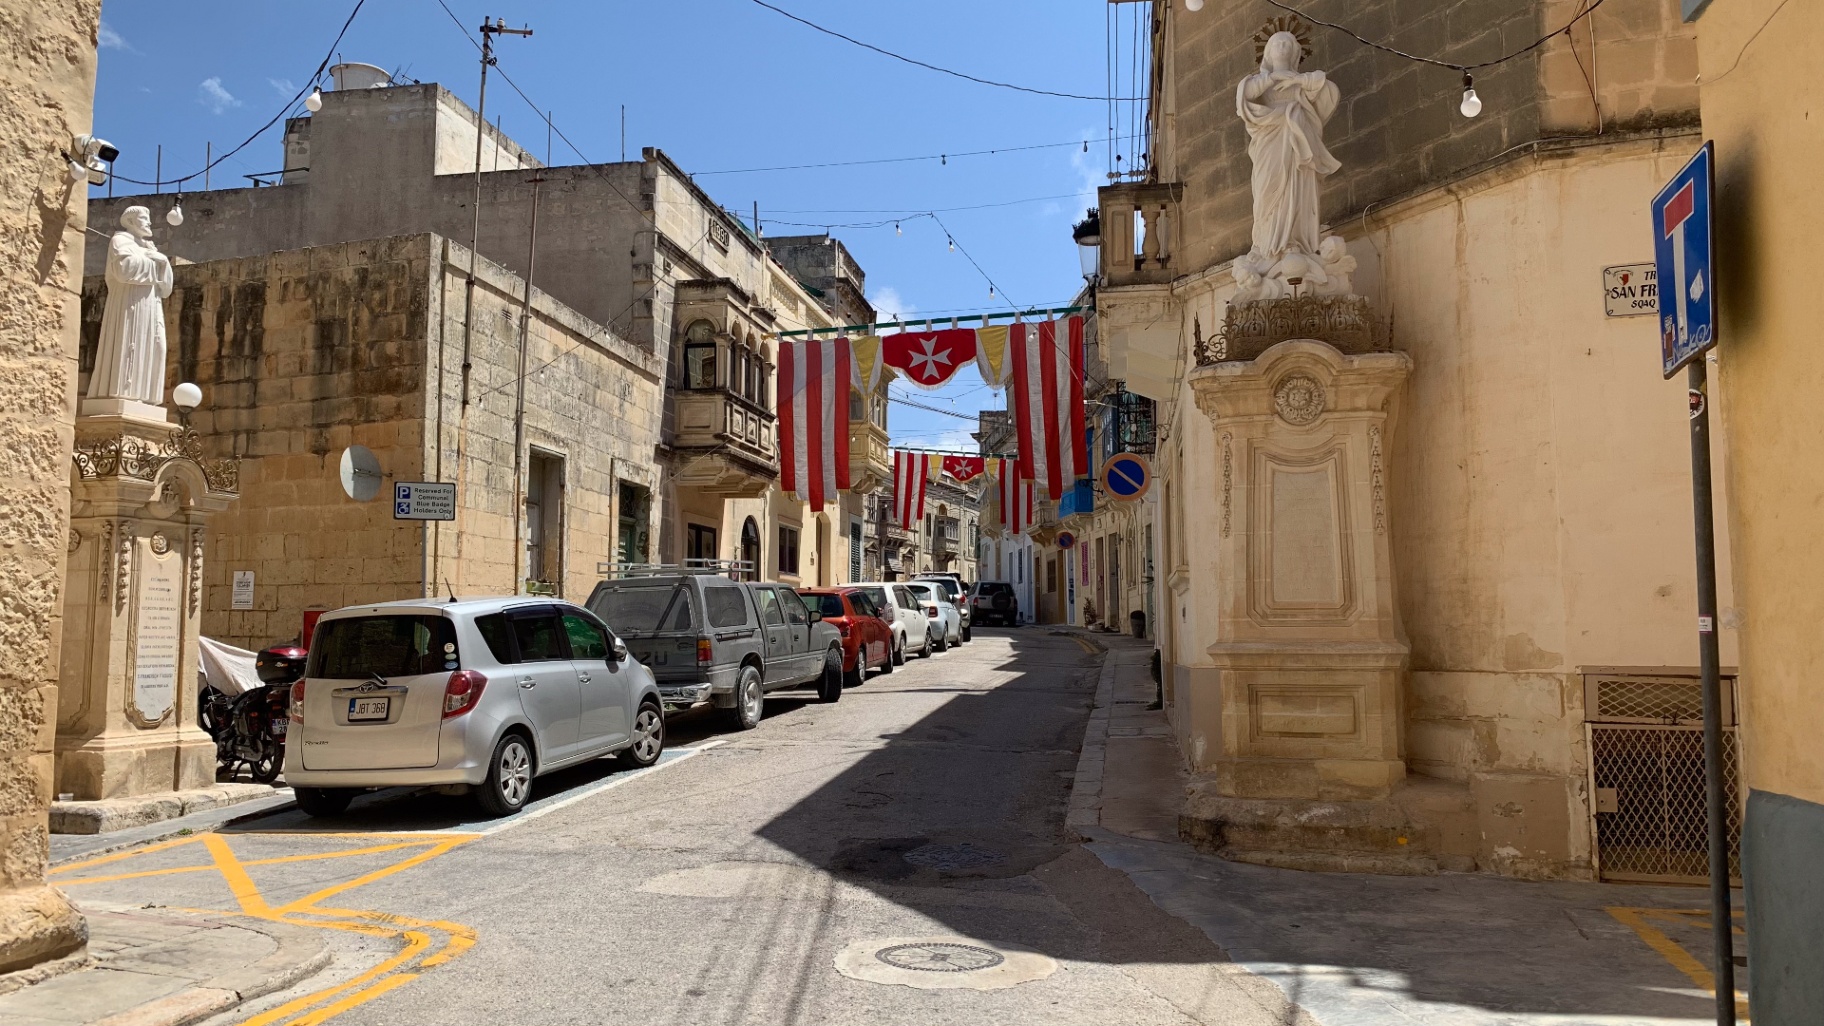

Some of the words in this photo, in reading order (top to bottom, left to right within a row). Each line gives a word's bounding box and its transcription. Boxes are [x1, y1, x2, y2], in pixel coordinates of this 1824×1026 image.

[1644, 270, 1657, 280] TR
[1611, 285, 1637, 299] SAN
[1640, 283, 1659, 297] FR
[1631, 298, 1656, 309] SQAQ
[399, 486, 409, 499] P
[356, 702, 370, 715] JBT
